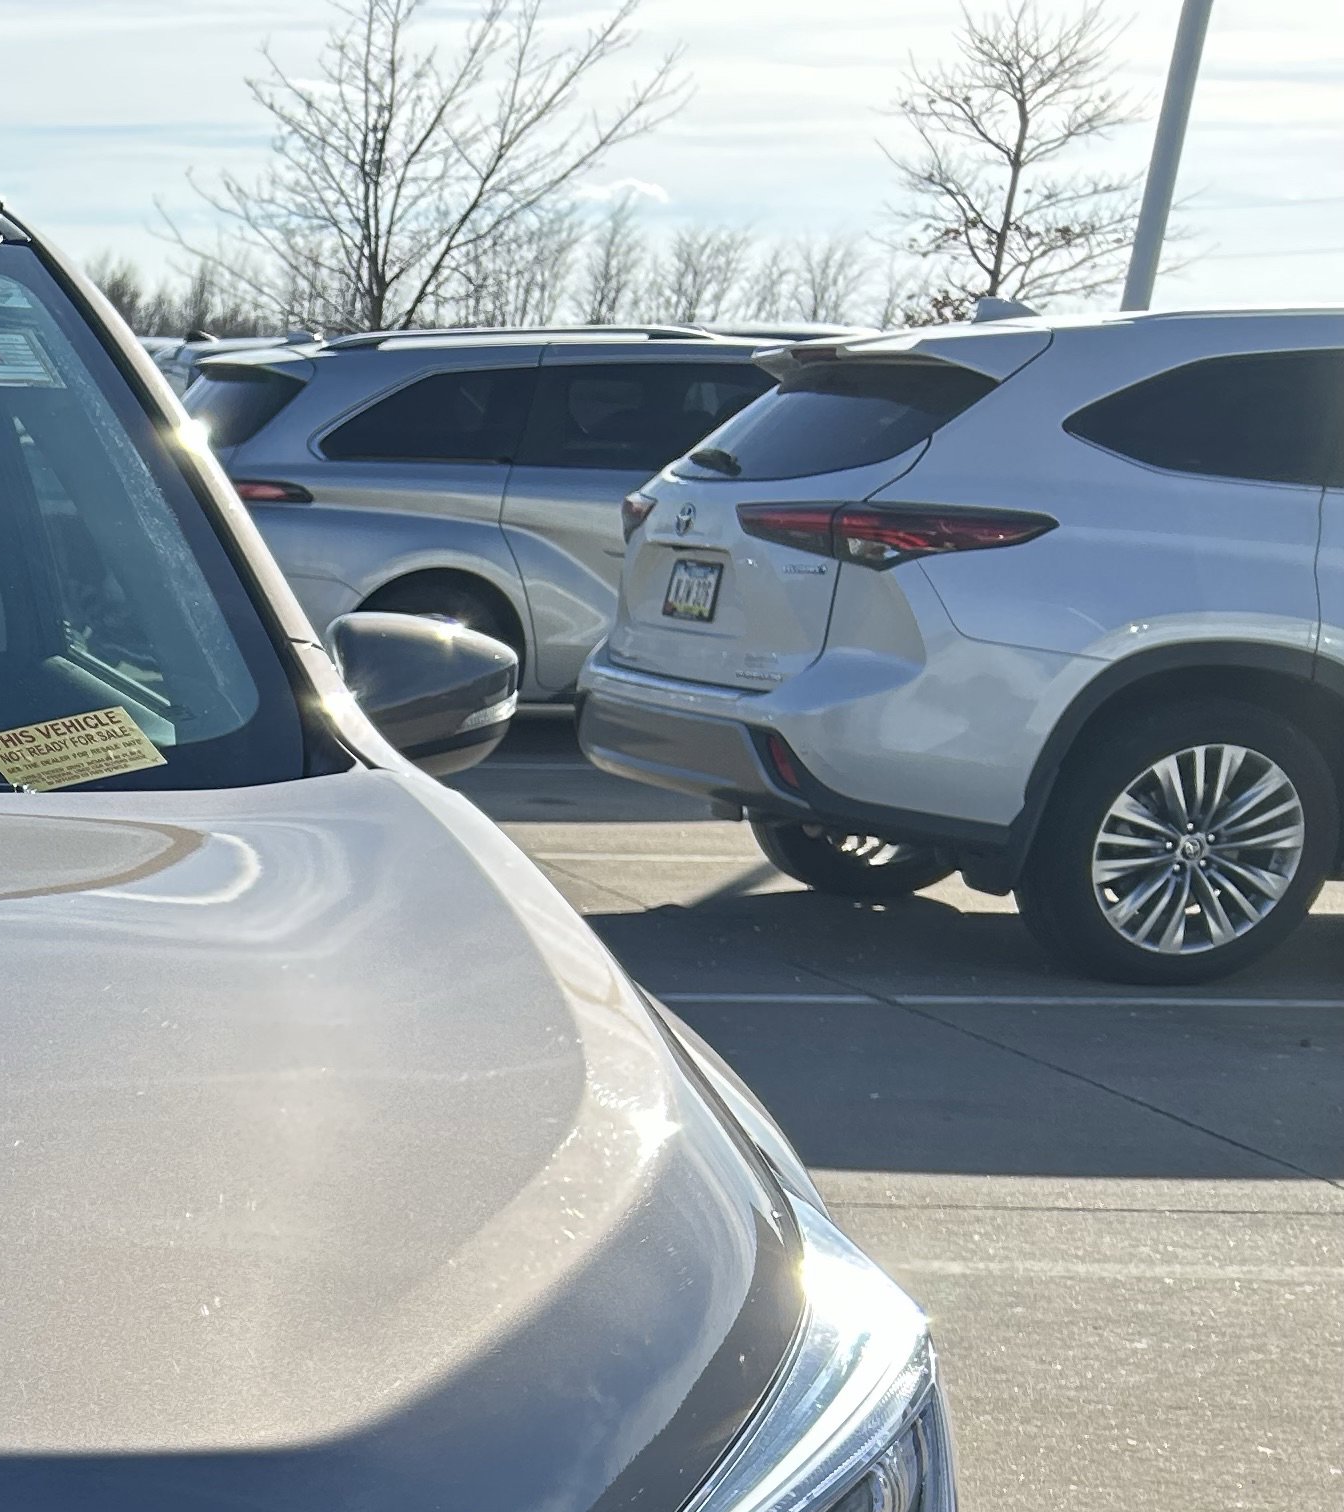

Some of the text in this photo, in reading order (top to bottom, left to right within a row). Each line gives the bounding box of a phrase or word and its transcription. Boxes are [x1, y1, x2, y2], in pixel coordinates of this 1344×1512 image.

[34, 710, 123, 740] VEHICLE
[28, 741, 71, 758] READY
[70, 733, 99, 748] FOR
[95, 725, 132, 743] SALE
